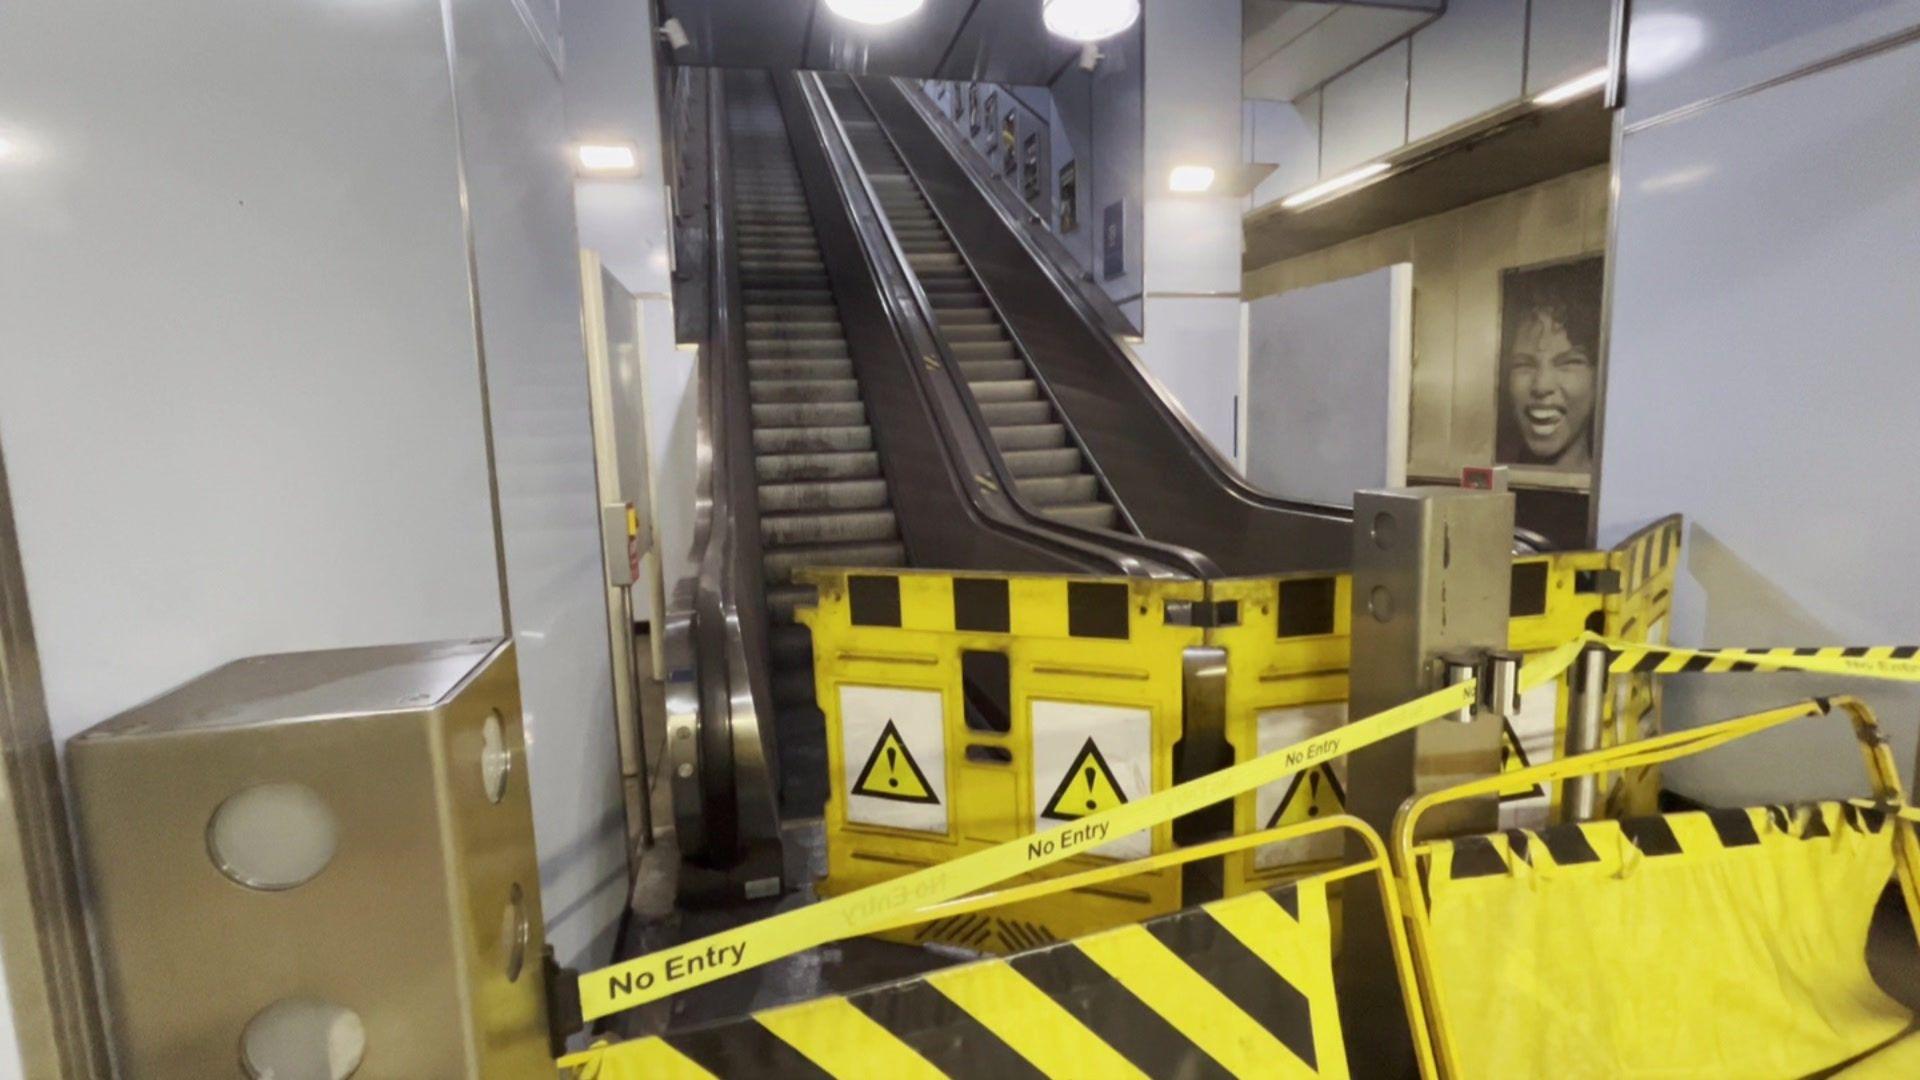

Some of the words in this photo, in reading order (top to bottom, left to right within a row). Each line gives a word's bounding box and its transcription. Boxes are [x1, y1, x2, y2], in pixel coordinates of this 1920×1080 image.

[1285, 752, 1304, 768] No
[1307, 738, 1341, 760] Entry
[1027, 839, 1055, 861] No
[1060, 821, 1109, 849] Entry
[609, 972, 654, 1000] No
[665, 941, 746, 981] Entry
